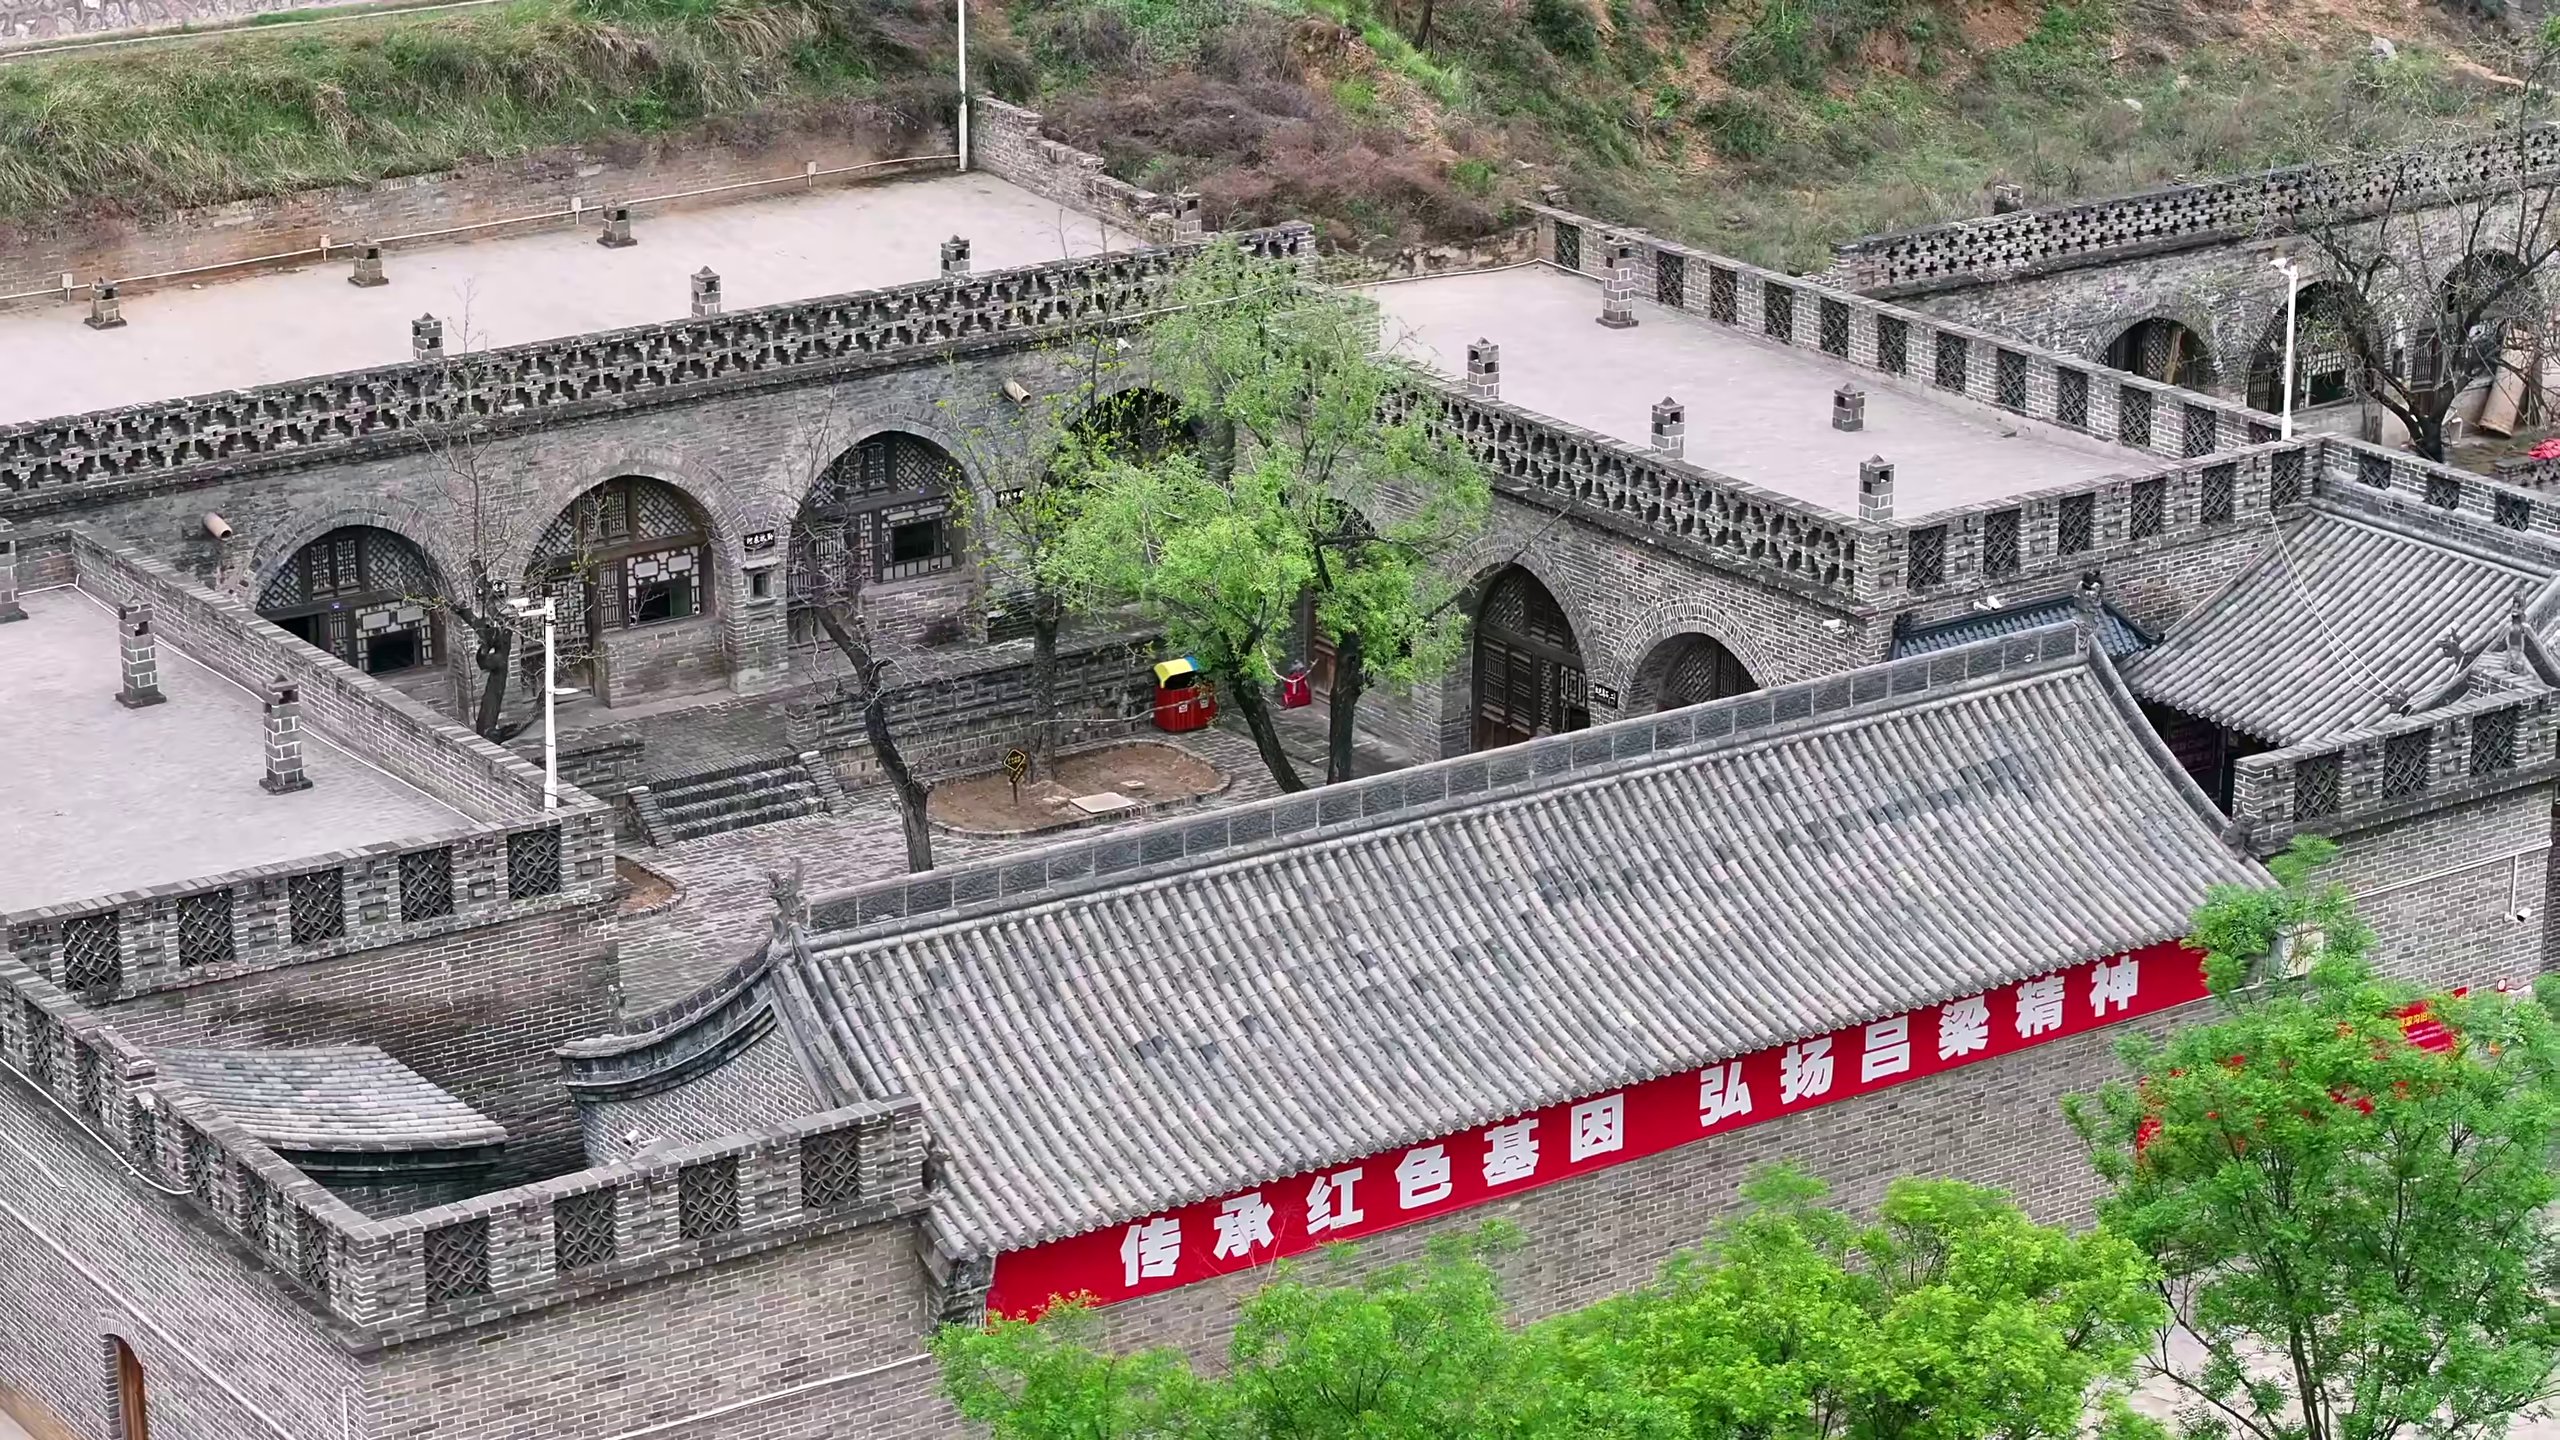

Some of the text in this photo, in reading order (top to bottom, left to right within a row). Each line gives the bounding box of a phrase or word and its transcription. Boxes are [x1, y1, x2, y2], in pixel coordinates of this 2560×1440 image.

[1120, 956, 2139, 1287] 传承红色基因 弘扬吕梁精神
